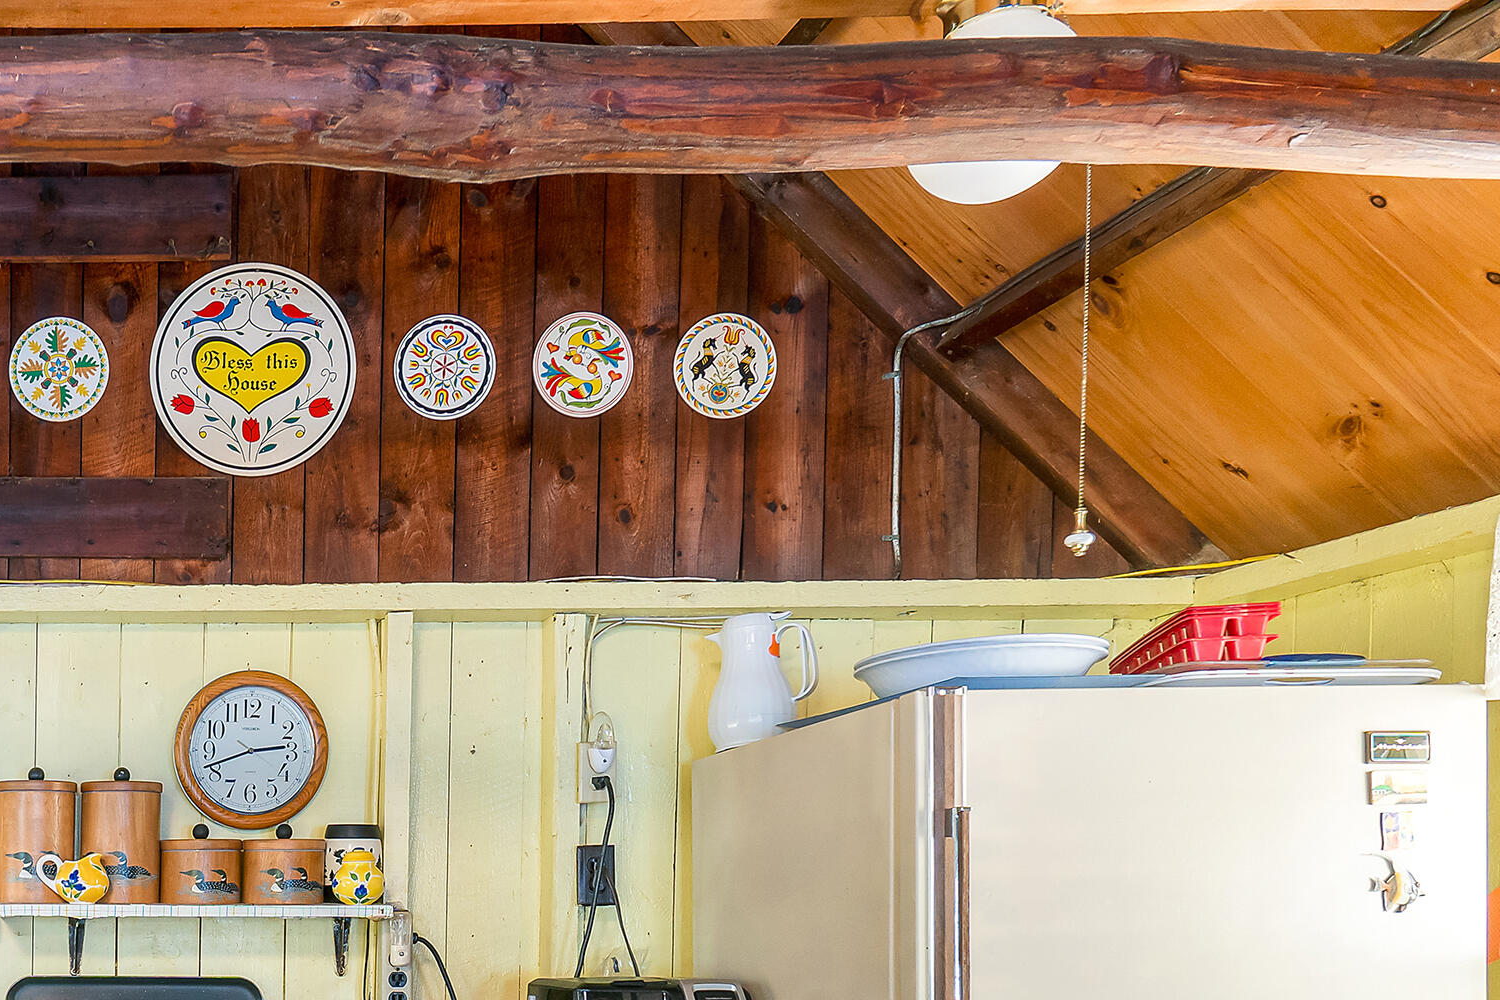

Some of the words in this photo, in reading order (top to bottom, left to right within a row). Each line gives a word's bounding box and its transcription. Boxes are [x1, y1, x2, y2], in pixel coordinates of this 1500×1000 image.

[200, 350, 254, 373] Bless
[266, 352, 298, 369] this
[223, 370, 277, 395] House
[226, 703, 237, 722] 11
[244, 699, 262, 718] 12
[208, 720, 225, 739] 10
[282, 720, 294, 740] 2
[203, 740, 216, 760] 9
[286, 741, 298, 762] 3
[209, 763, 221, 782] 8
[278, 762, 289, 782] 4
[225, 779, 236, 798] 7
[244, 783, 257, 803] 6
[266, 778, 277, 798] 5
